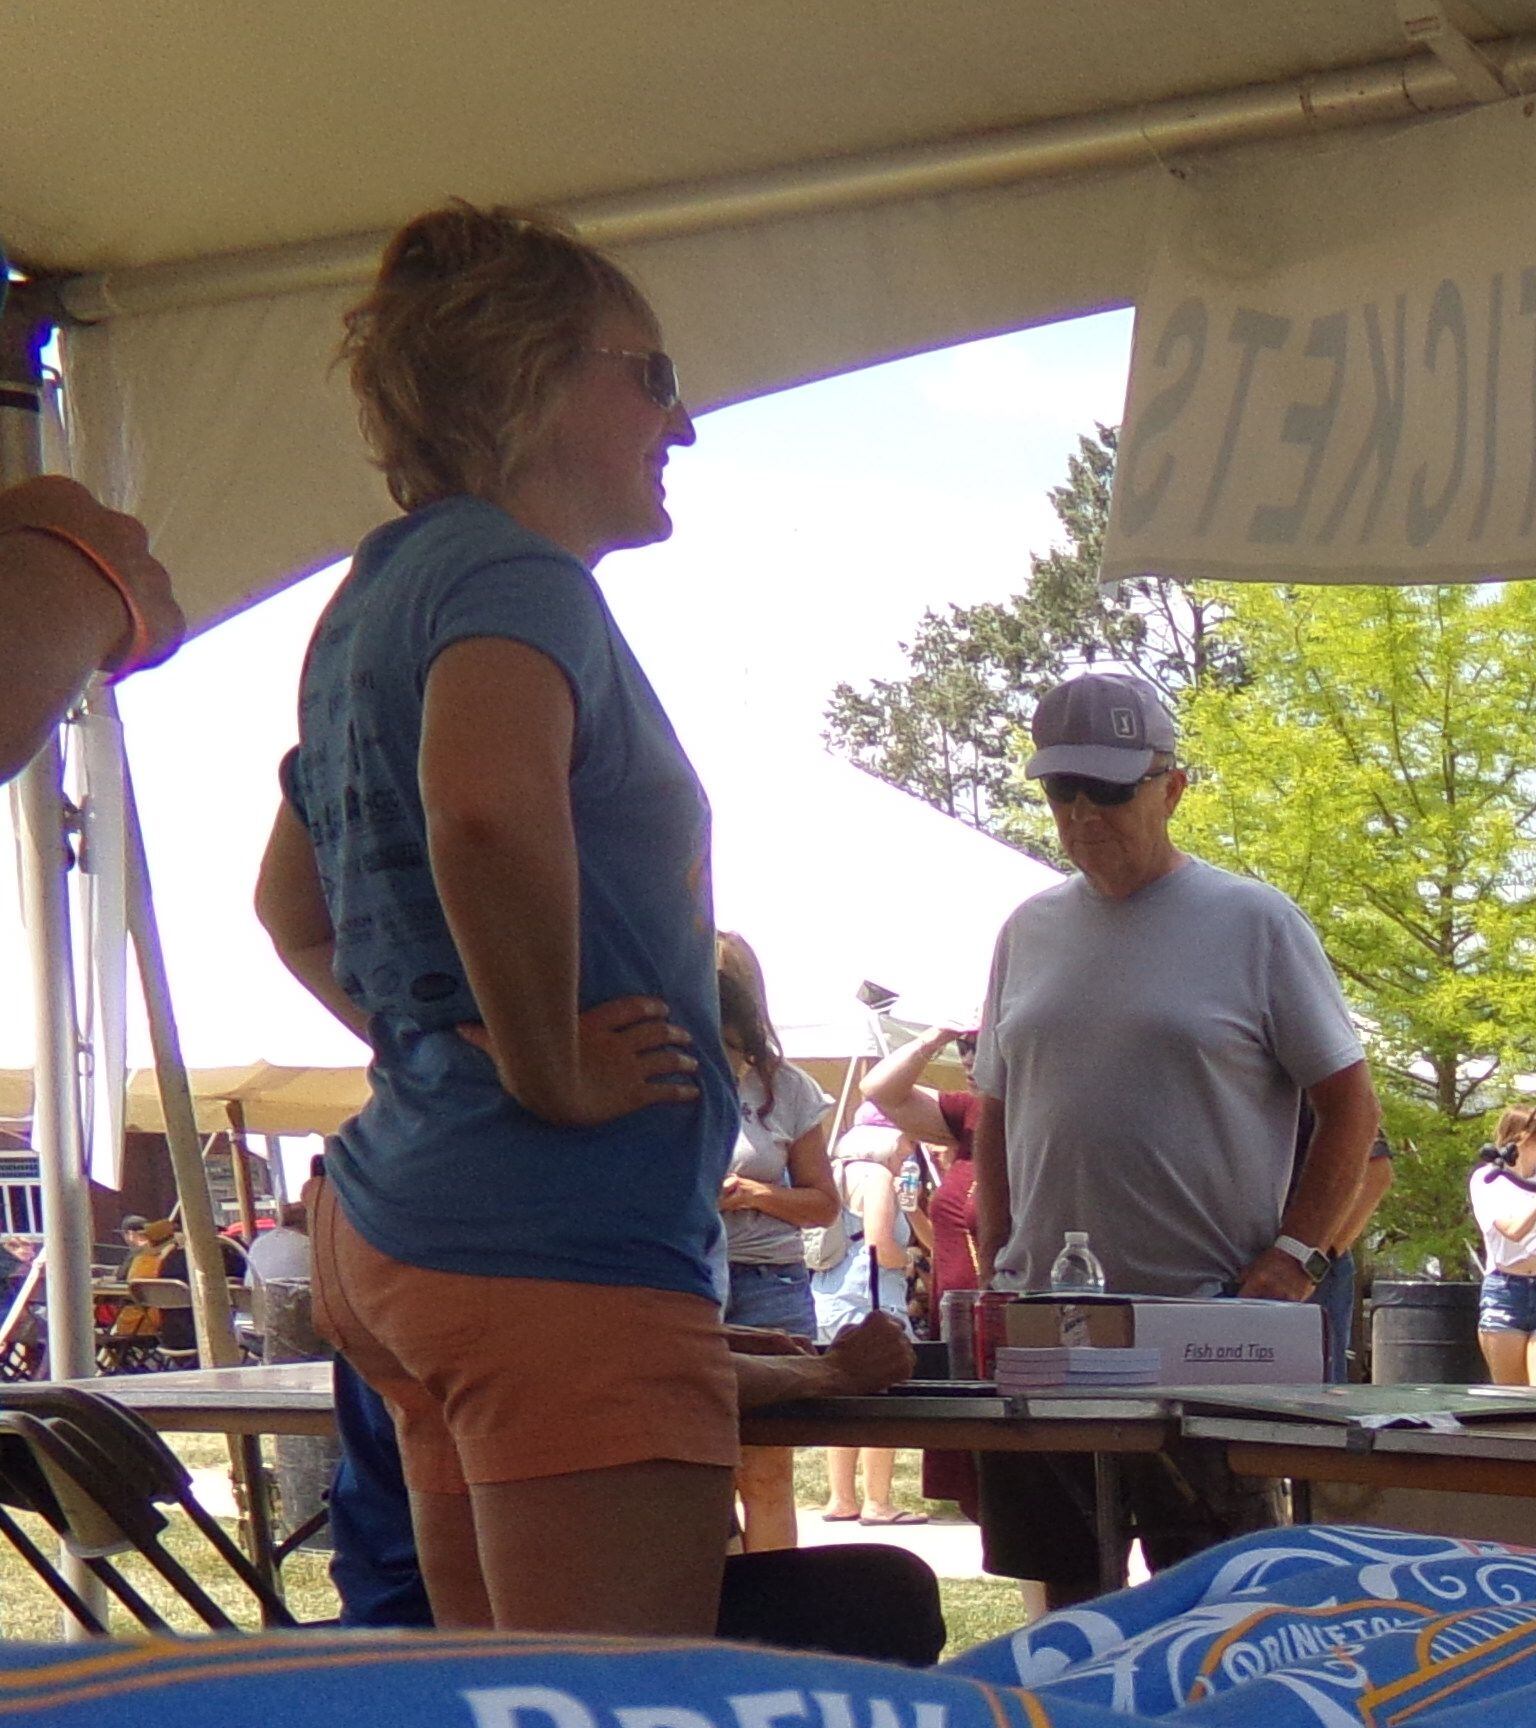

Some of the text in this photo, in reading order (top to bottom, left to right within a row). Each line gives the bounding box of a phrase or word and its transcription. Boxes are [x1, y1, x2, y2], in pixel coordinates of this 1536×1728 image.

[1184, 1343, 1275, 1359] Fish and Tips
